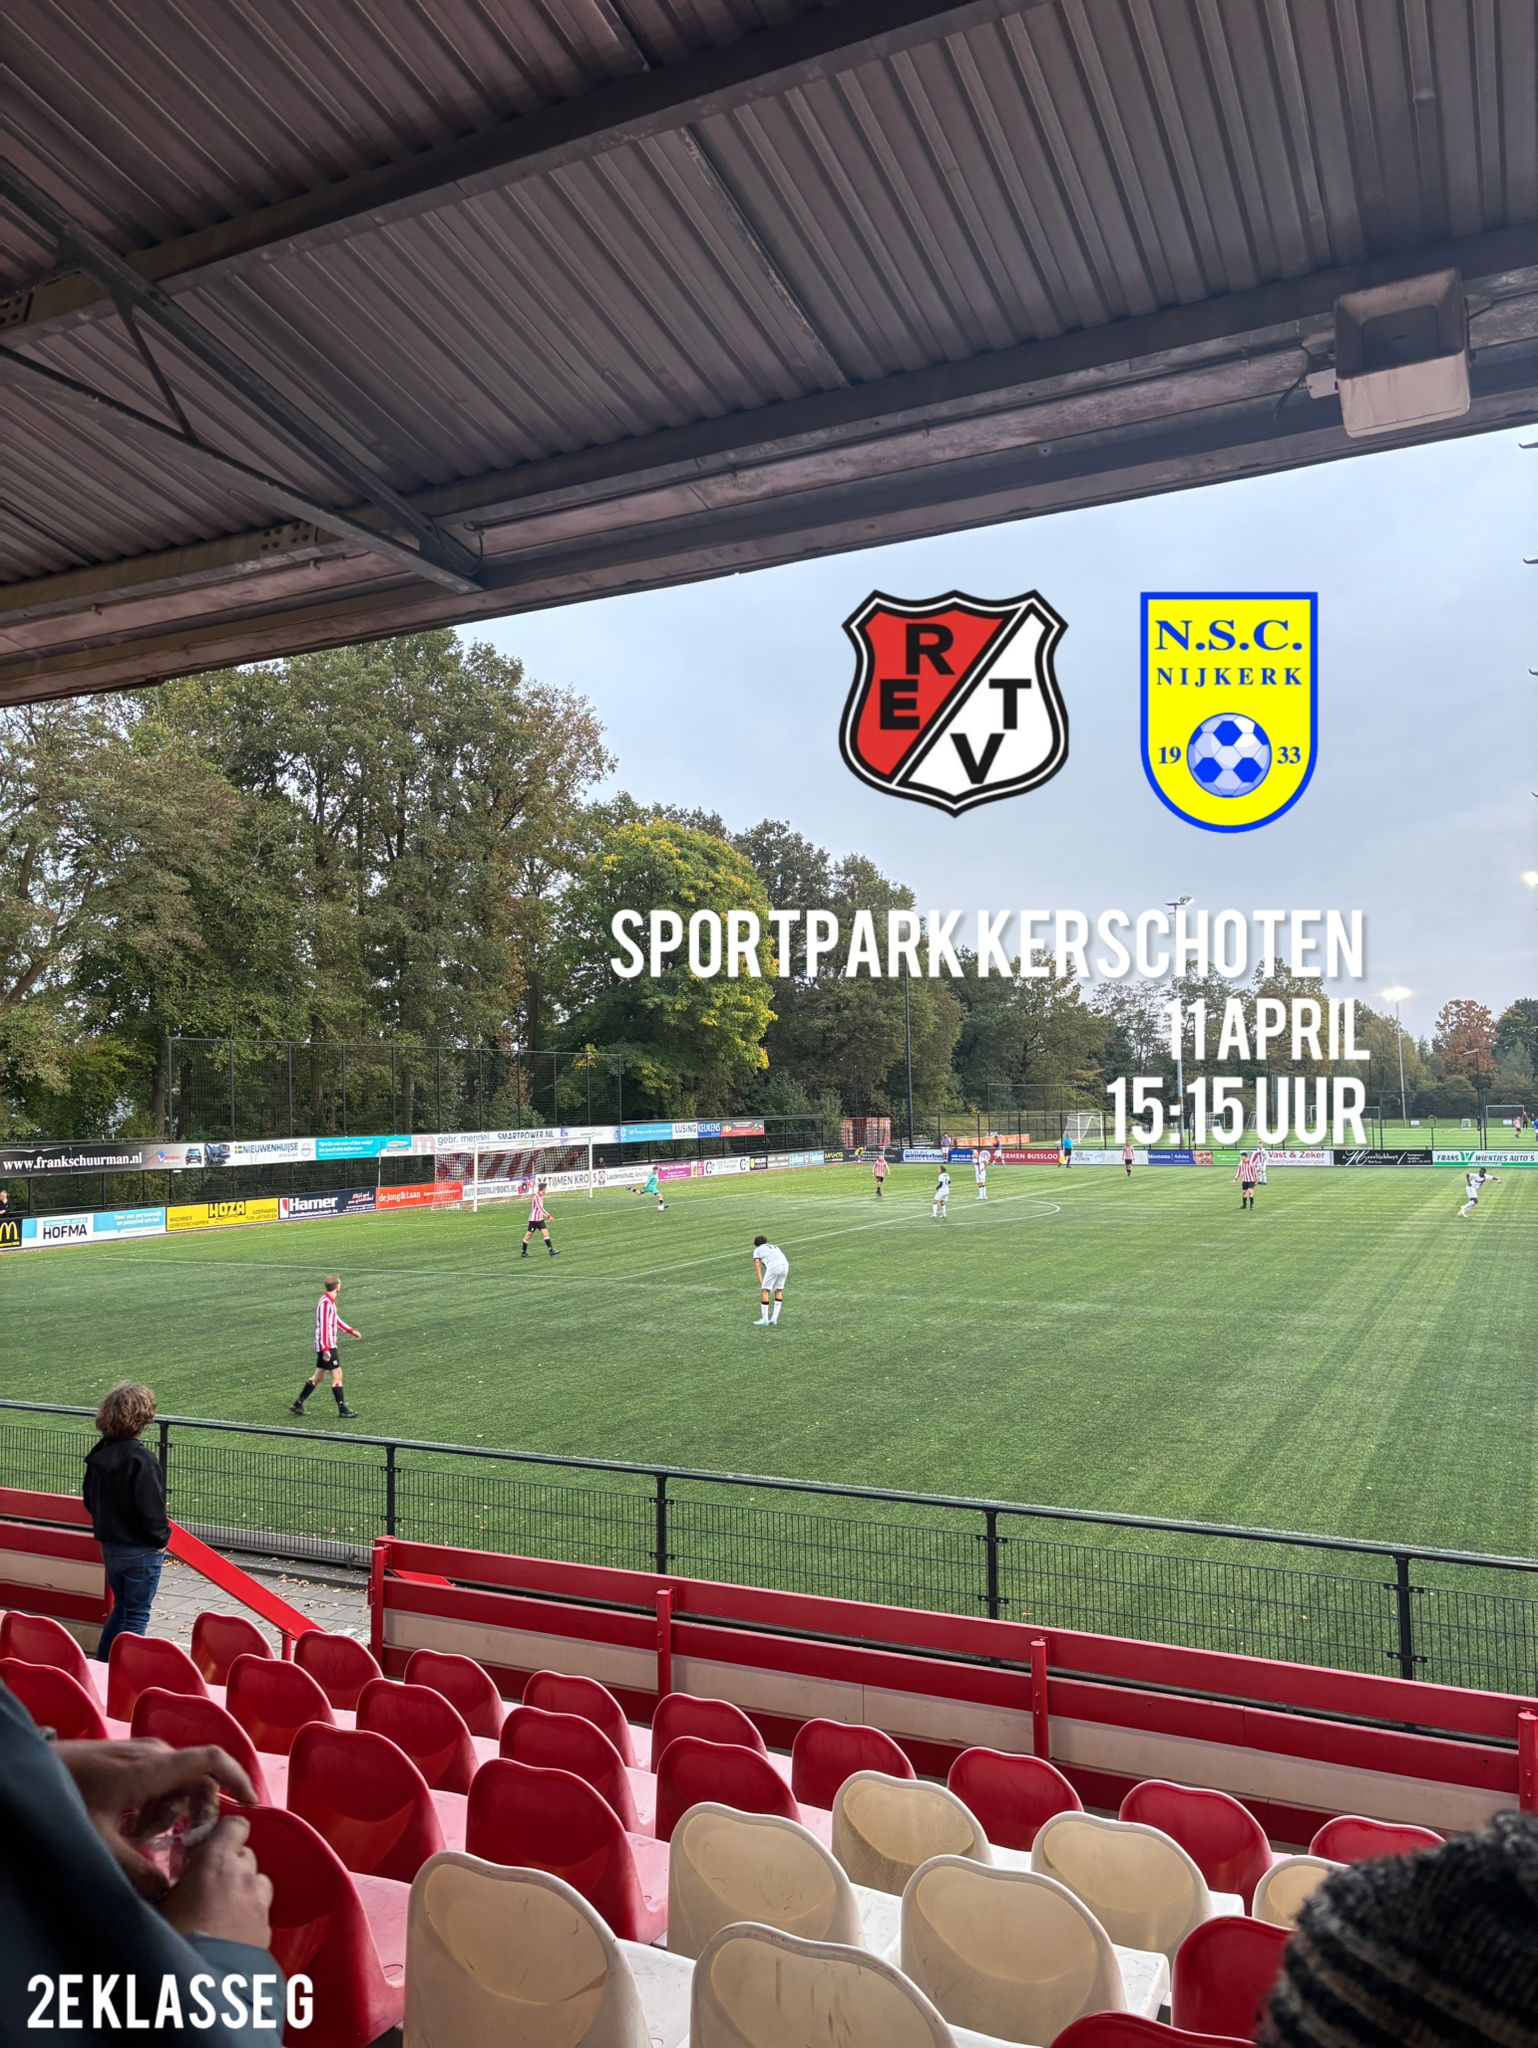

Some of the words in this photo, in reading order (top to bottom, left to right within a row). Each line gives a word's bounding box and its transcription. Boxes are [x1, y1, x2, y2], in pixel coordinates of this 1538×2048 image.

[497, 1129, 554, 1141] SMARTPOWER.NL
[675, 1123, 697, 1134] LUSING
[3, 1152, 142, 1171] www.frankschuurman.nl
[1268, 1151, 1287, 1159] Vast
[1299, 1151, 1325, 1159] Zeker
[208, 1200, 246, 1218] HOZA
[289, 1197, 338, 1212] Hamer
[43, 1224, 87, 1239] HOFMA
